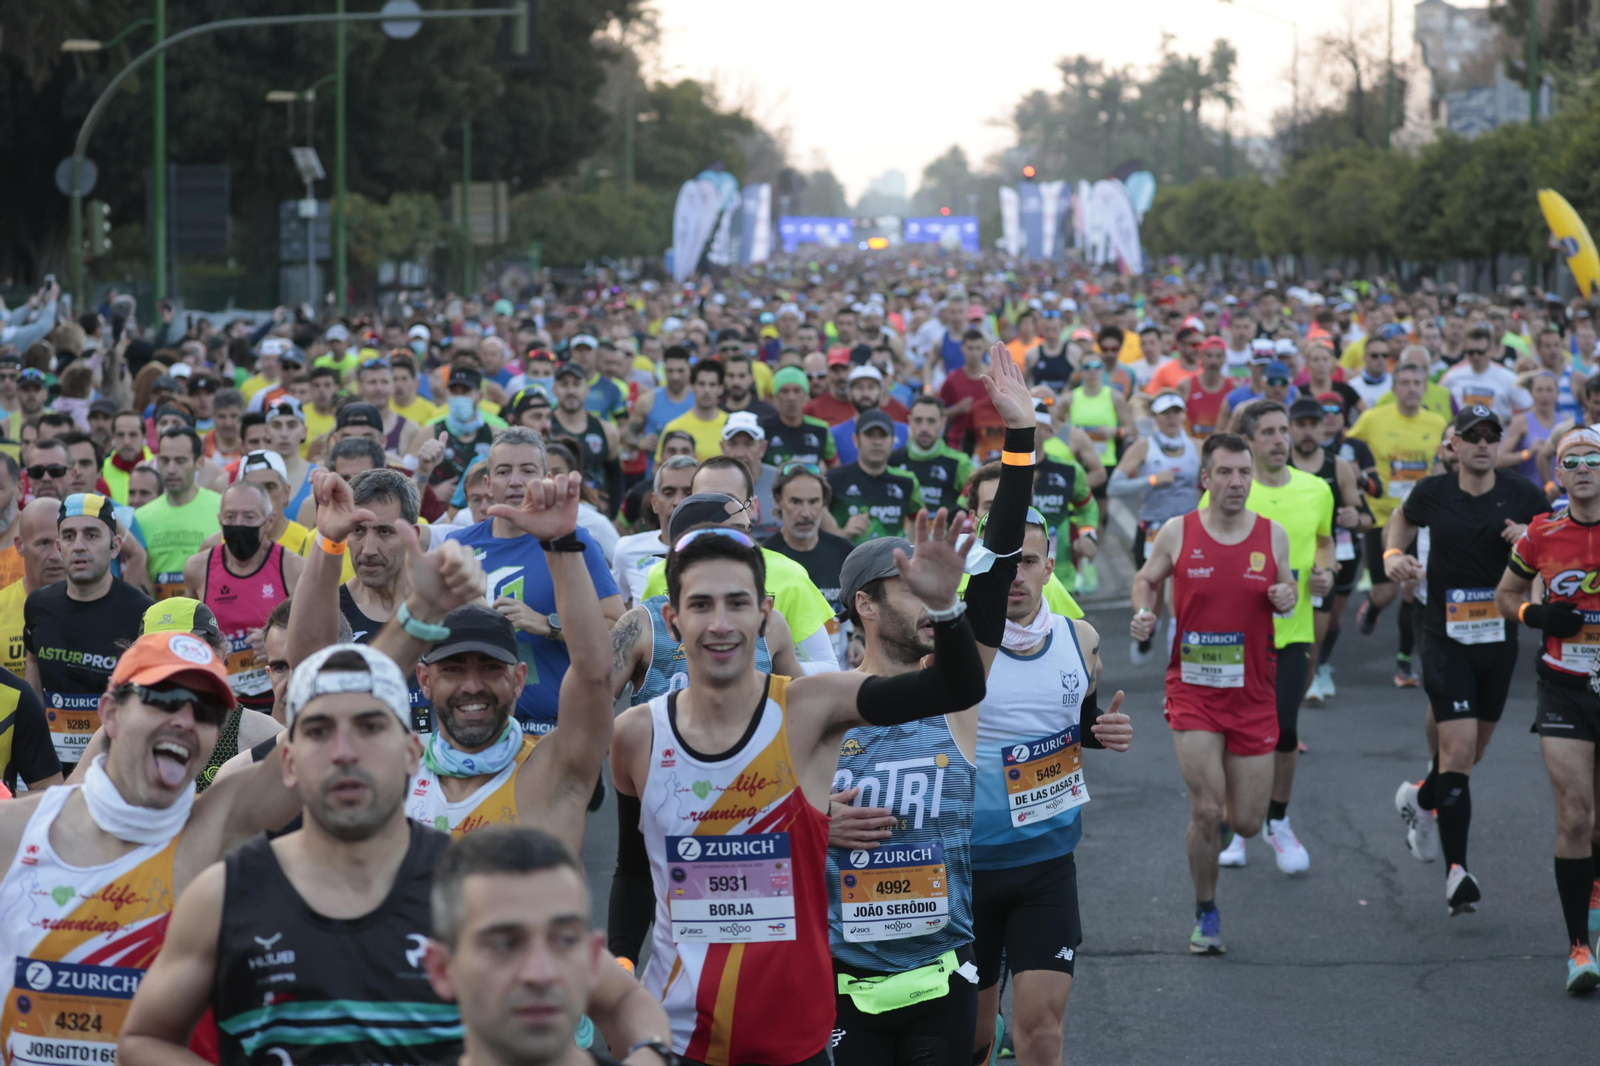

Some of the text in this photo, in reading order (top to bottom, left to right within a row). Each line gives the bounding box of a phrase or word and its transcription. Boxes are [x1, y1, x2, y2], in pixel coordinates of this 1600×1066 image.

[1467, 591, 1495, 600] ZURIC
[1201, 635, 1237, 644] ZURICH
[38, 646, 117, 669] ASTURPRO
[1062, 693, 1079, 705] OTSO
[67, 719, 90, 730] 5289
[521, 722, 555, 733] URICH
[1032, 731, 1072, 756] ZURICH
[1036, 762, 1061, 782] 5492
[736, 772, 766, 797] life
[1015, 794, 1028, 805] DE
[1030, 789, 1048, 802] LAS
[1050, 777, 1073, 795] CASAS
[690, 804, 757, 825] running
[705, 840, 775, 856] ZURICH
[873, 848, 932, 864] ZURICH
[709, 875, 748, 892] 5931
[876, 879, 911, 895] 4992
[101, 883, 137, 911] life
[709, 903, 754, 916] BORJA
[853, 900, 937, 917] JOÃO SERÔDIO
[41, 916, 119, 940] running
[56, 970, 138, 993] ZURICH
[55, 1011, 103, 1033] 4324
